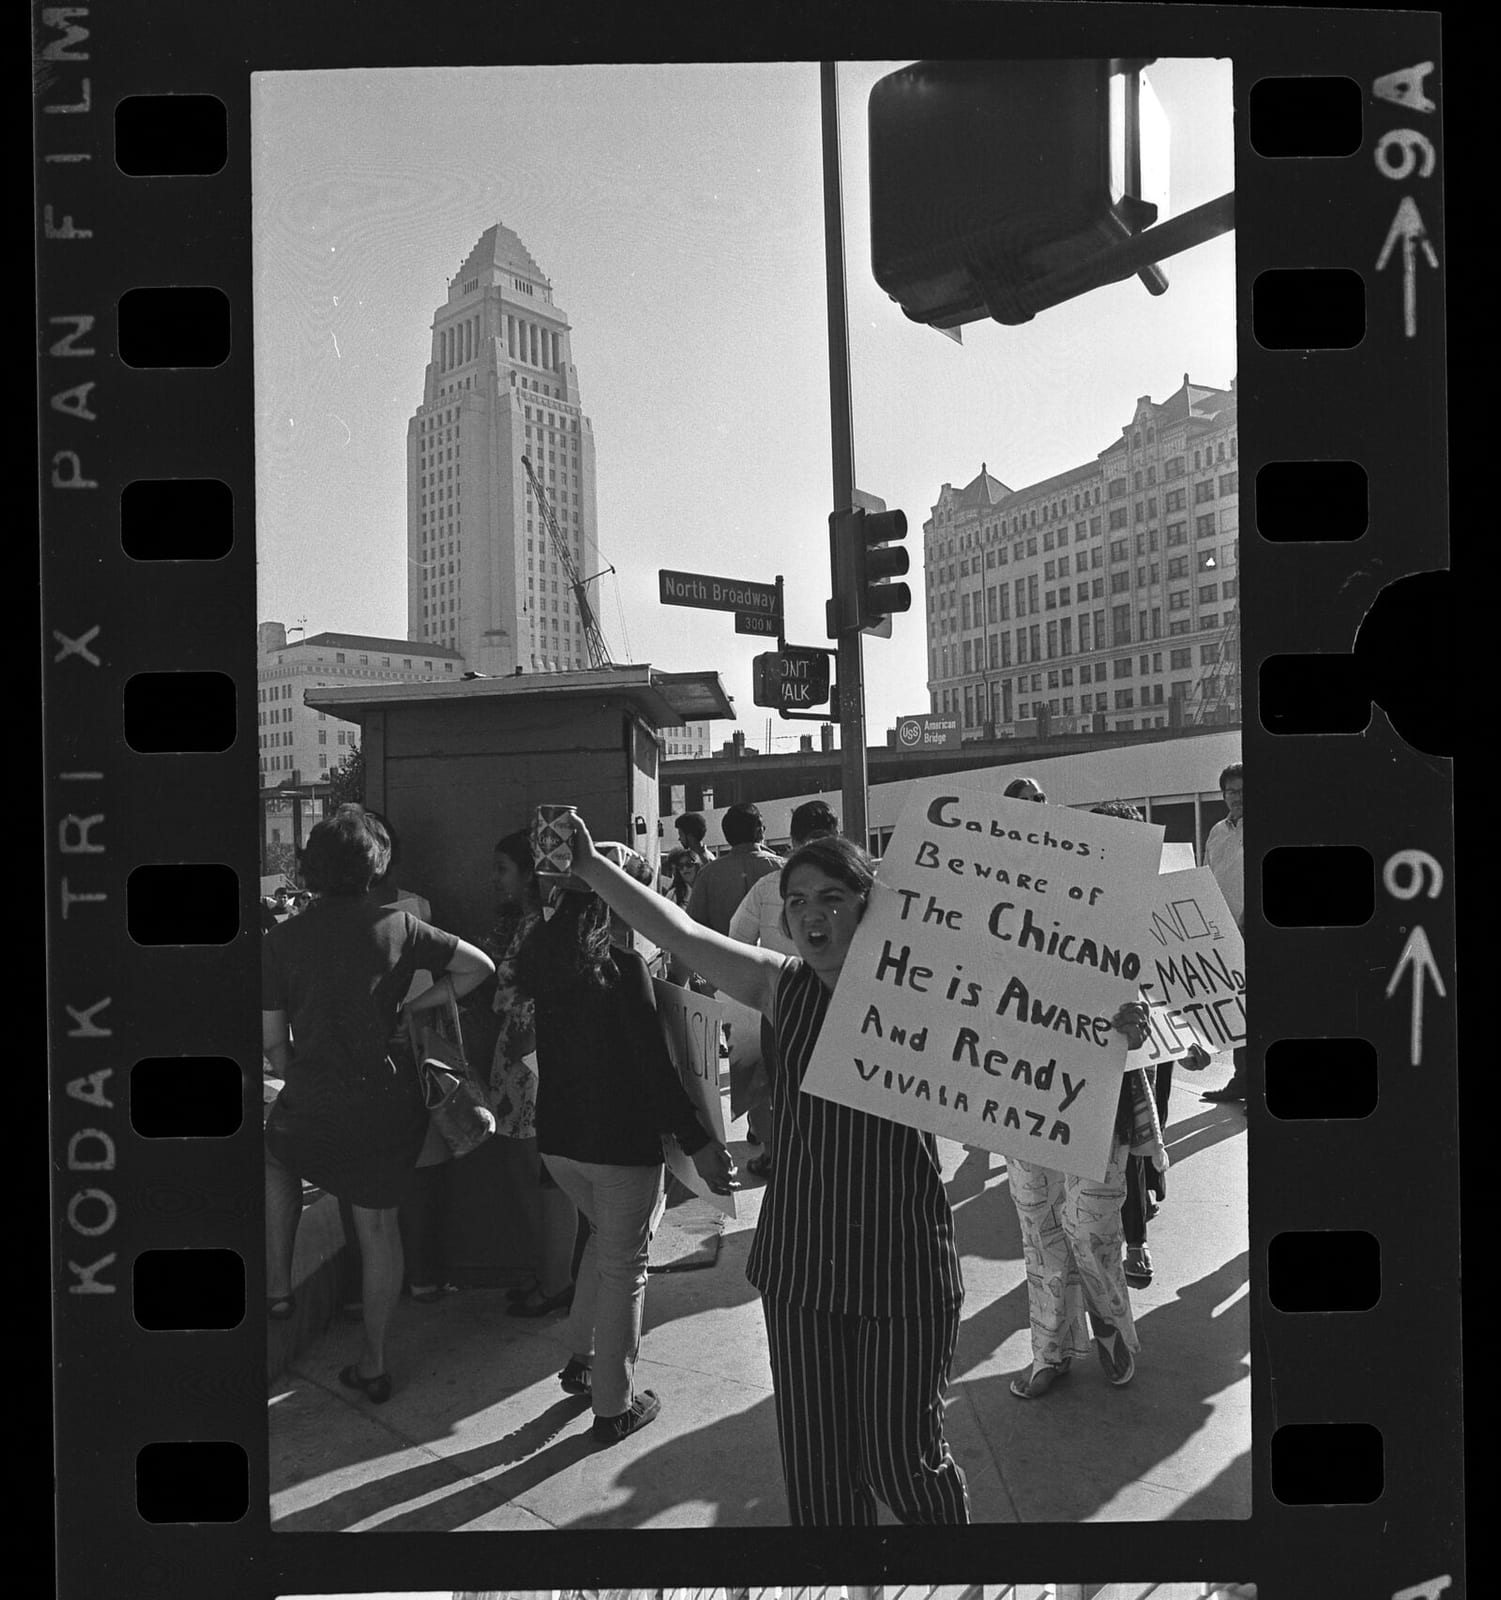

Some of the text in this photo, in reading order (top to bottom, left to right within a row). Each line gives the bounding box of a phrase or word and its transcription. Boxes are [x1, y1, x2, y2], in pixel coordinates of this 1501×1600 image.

[665, 577, 776, 613] North Broadway
[745, 617, 773, 631] 300 N
[41, 6, 116, 1294] KODAK TRI X PAN FILM
[780, 659, 810, 678] ON'T
[902, 726, 919, 740] USS
[924, 720, 956, 730] American
[924, 732, 947, 745] Bridge
[898, 889, 963, 931] The
[875, 939, 934, 993] He
[946, 964, 983, 1008] is
[982, 1099, 1070, 1145] RAZA
